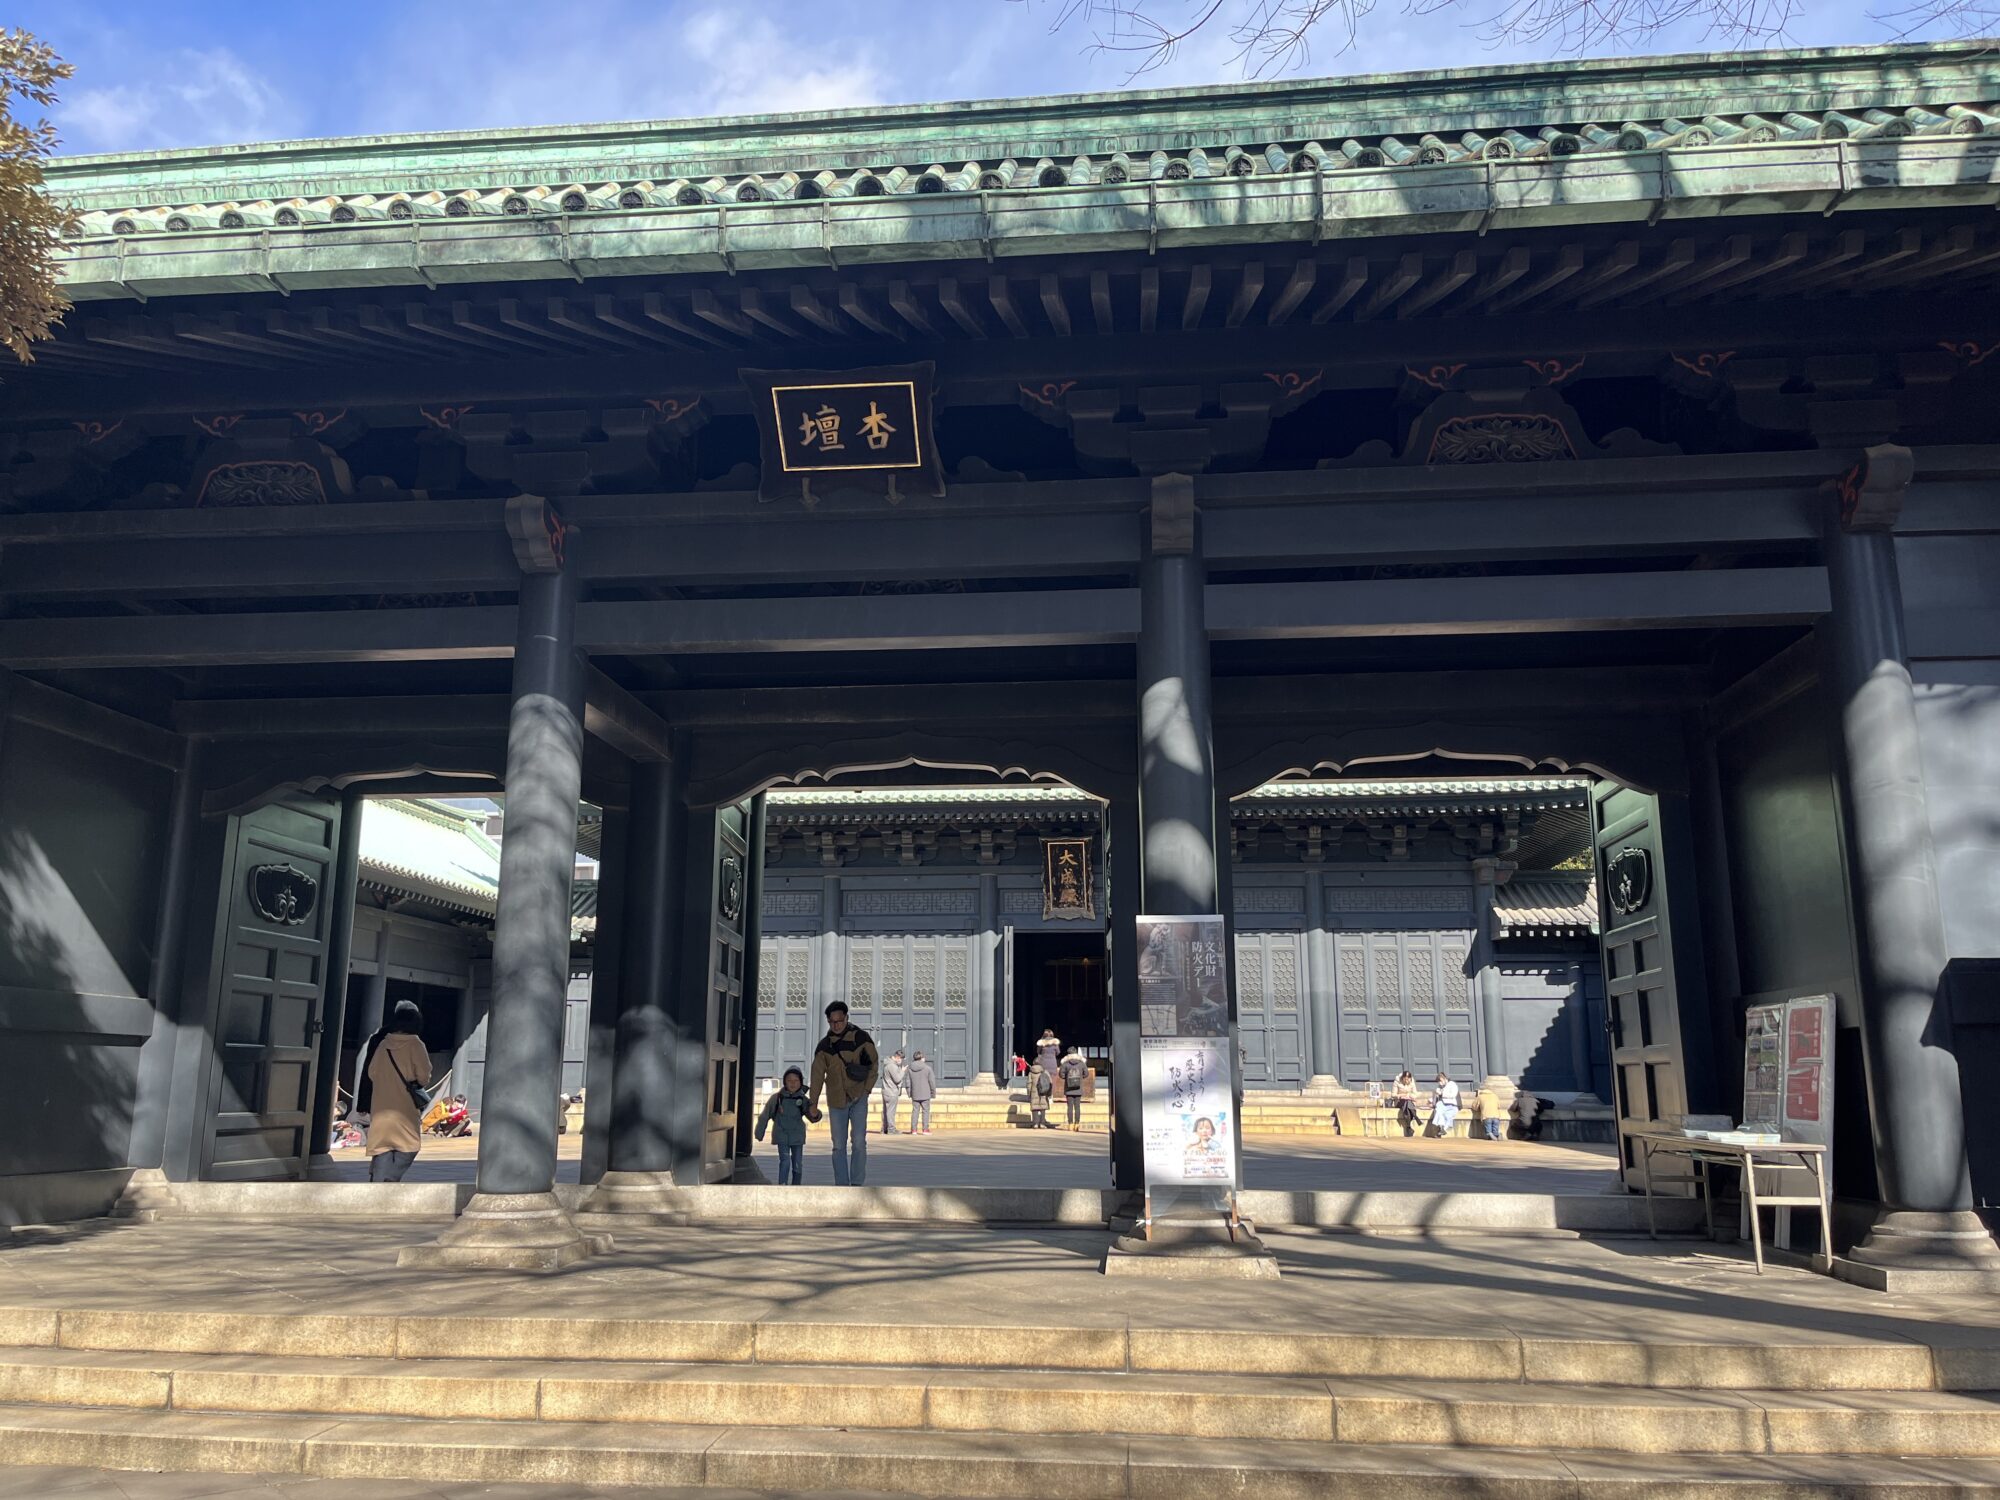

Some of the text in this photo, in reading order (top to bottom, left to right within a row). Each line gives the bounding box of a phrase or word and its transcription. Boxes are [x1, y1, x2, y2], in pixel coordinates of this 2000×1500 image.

[1191, 941, 1204, 988] 防火デー
[1205, 941, 1217, 977] 文化財
